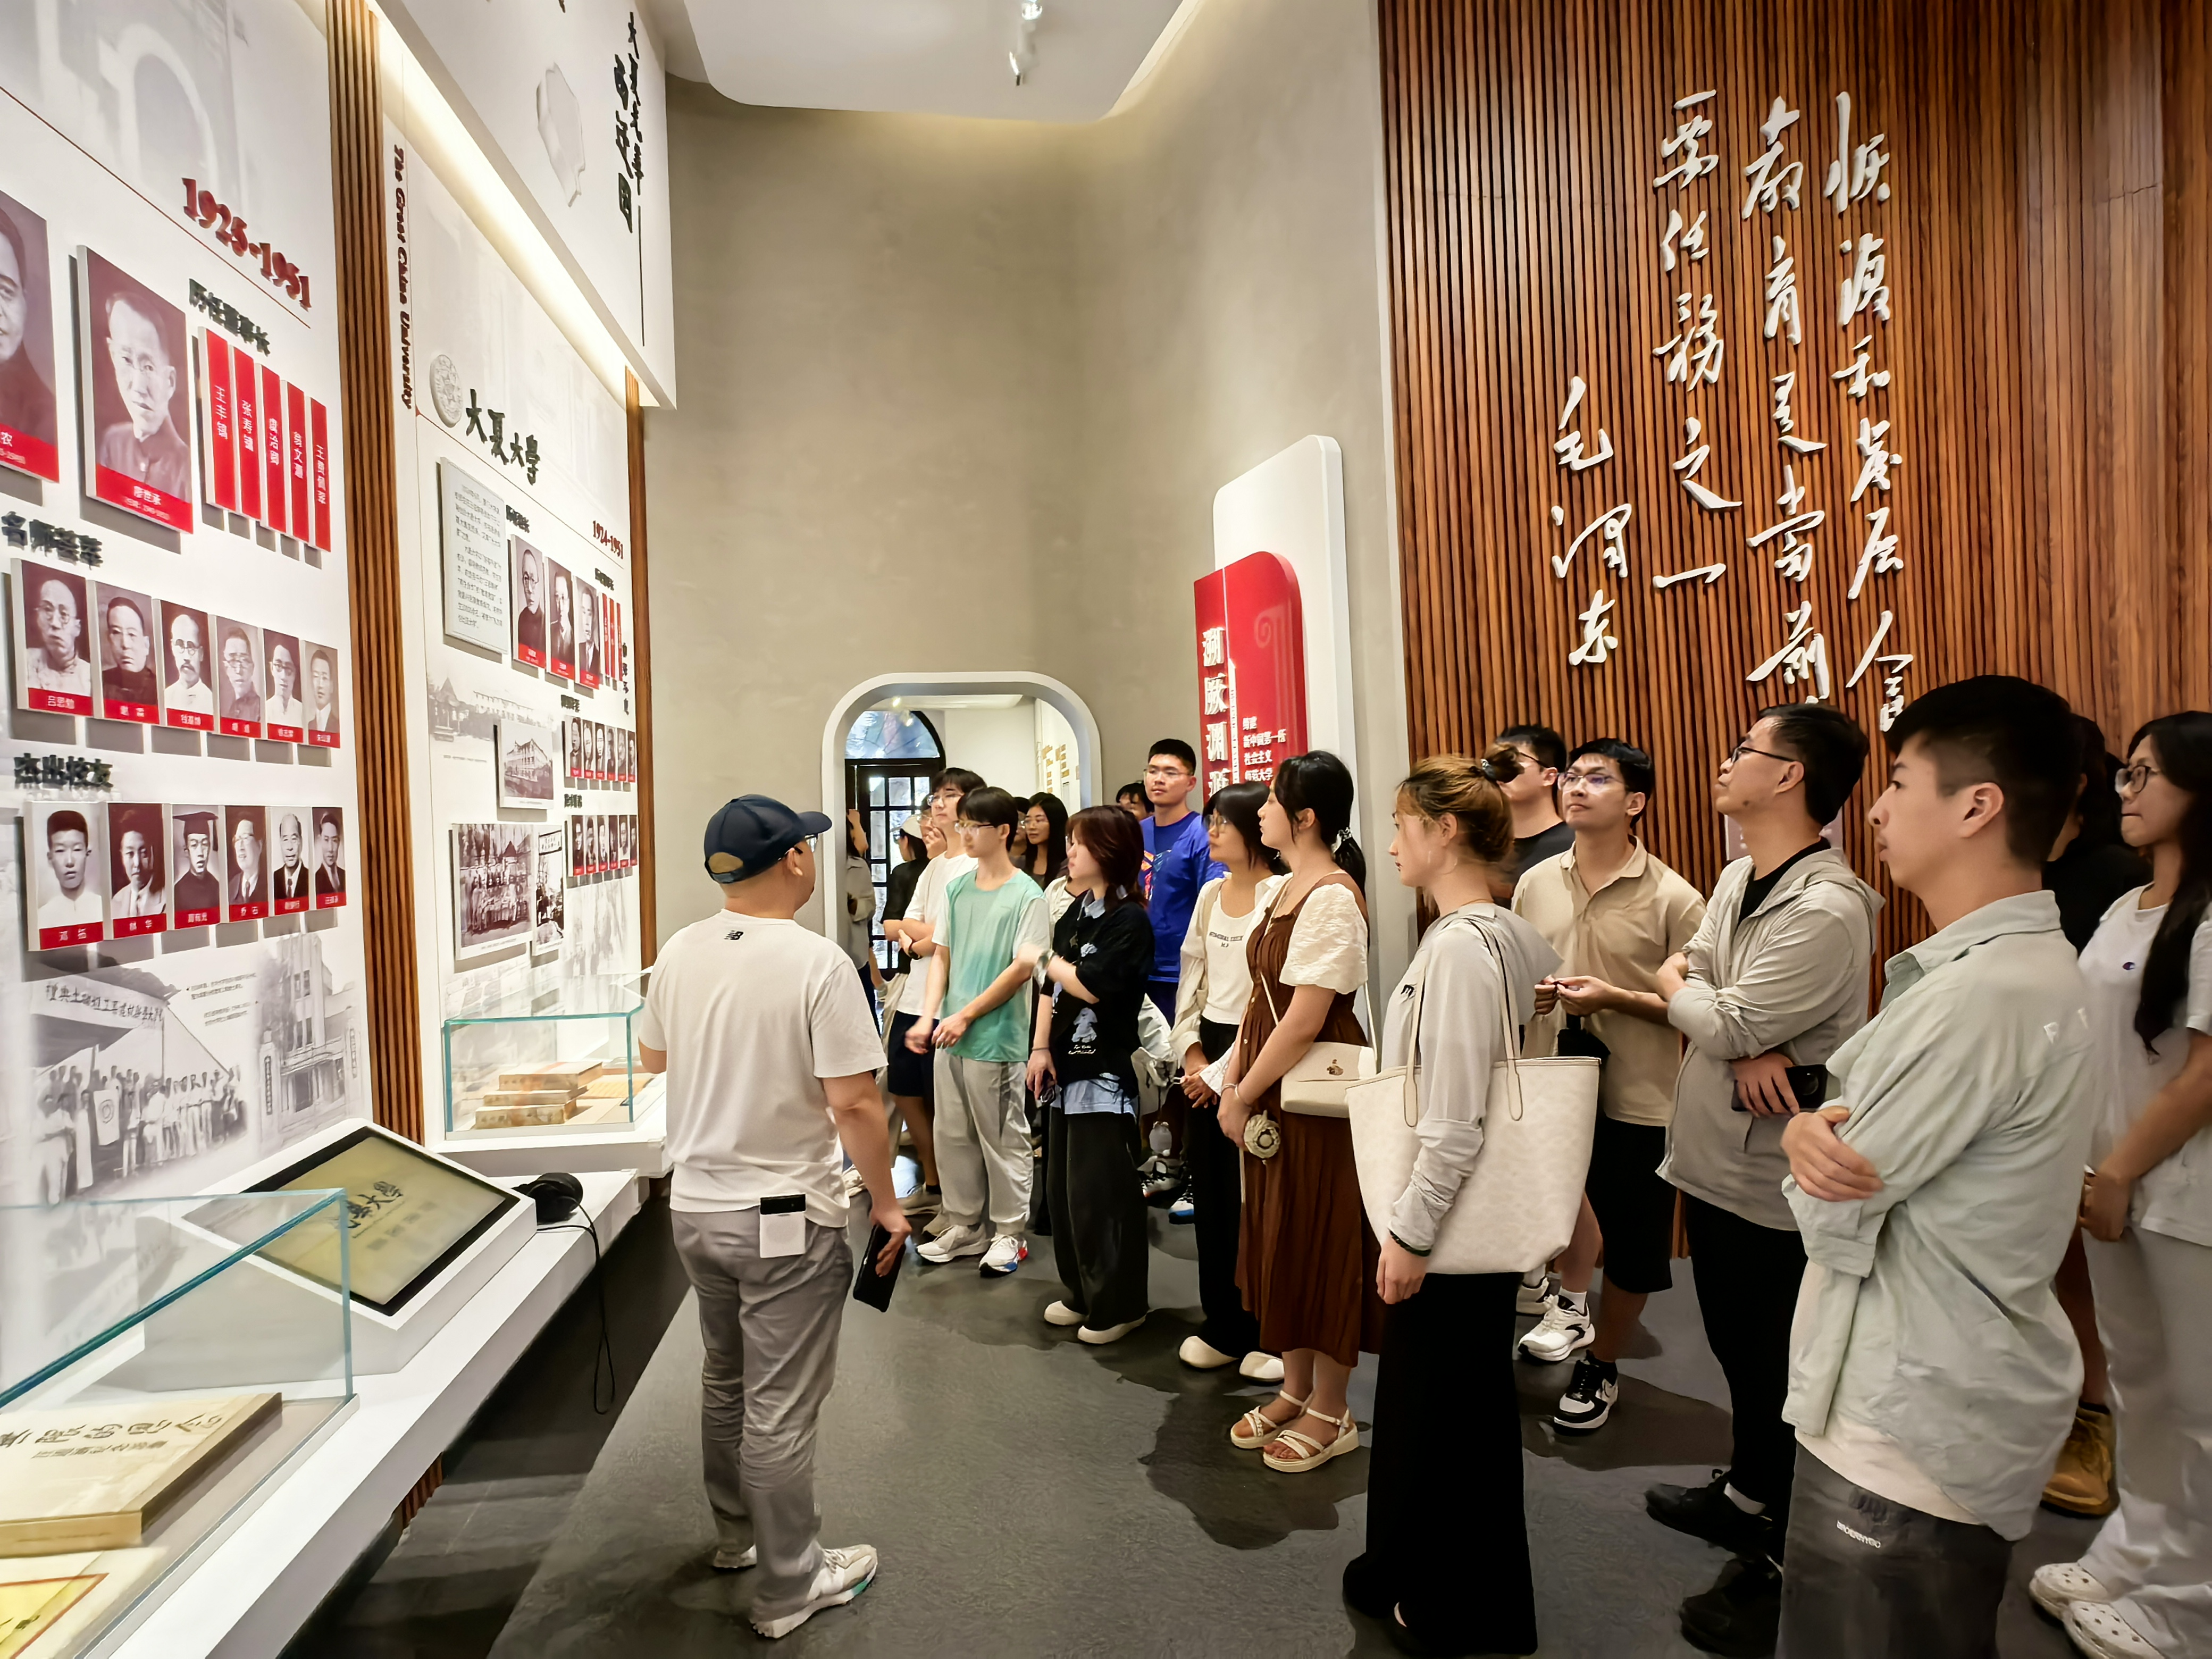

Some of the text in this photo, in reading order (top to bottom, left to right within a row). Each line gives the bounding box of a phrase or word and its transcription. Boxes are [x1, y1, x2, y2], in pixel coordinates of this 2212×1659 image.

[181, 177, 312, 312] 1925-1951
[592, 520, 624, 560] 1924-1951
[1243, 728, 1287, 748] 新中国第一所
[1244, 749, 1273, 765] 社会主义
[1245, 767, 1273, 782] 师范大学
